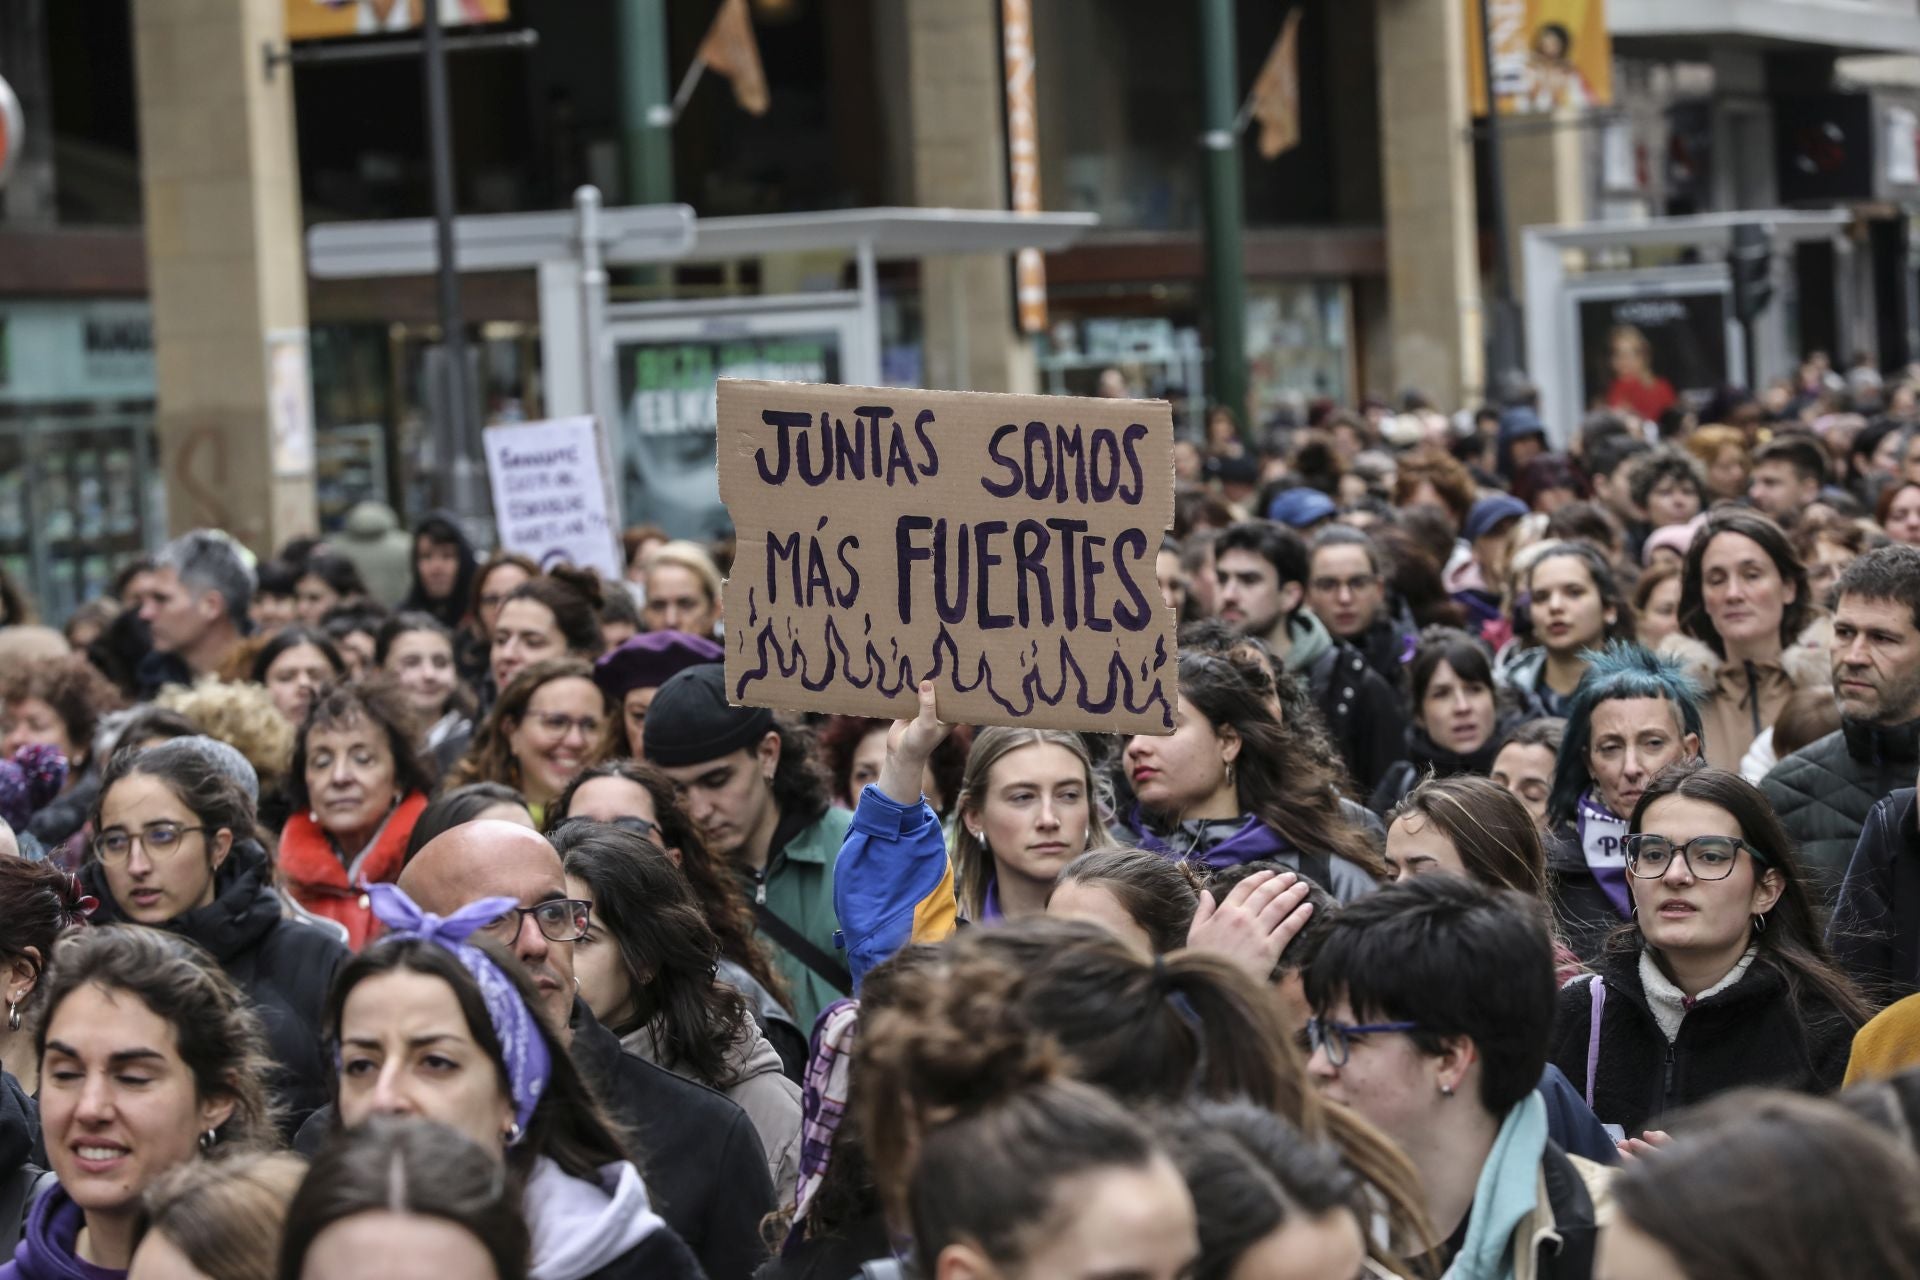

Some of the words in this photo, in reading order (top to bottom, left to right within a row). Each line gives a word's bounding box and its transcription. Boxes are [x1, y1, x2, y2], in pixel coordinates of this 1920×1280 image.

[755, 406, 939, 487] JUNTAS
[981, 420, 1149, 505] SOMOS
[766, 515, 860, 609] MÁS
[895, 514, 1152, 632] FUERTES
